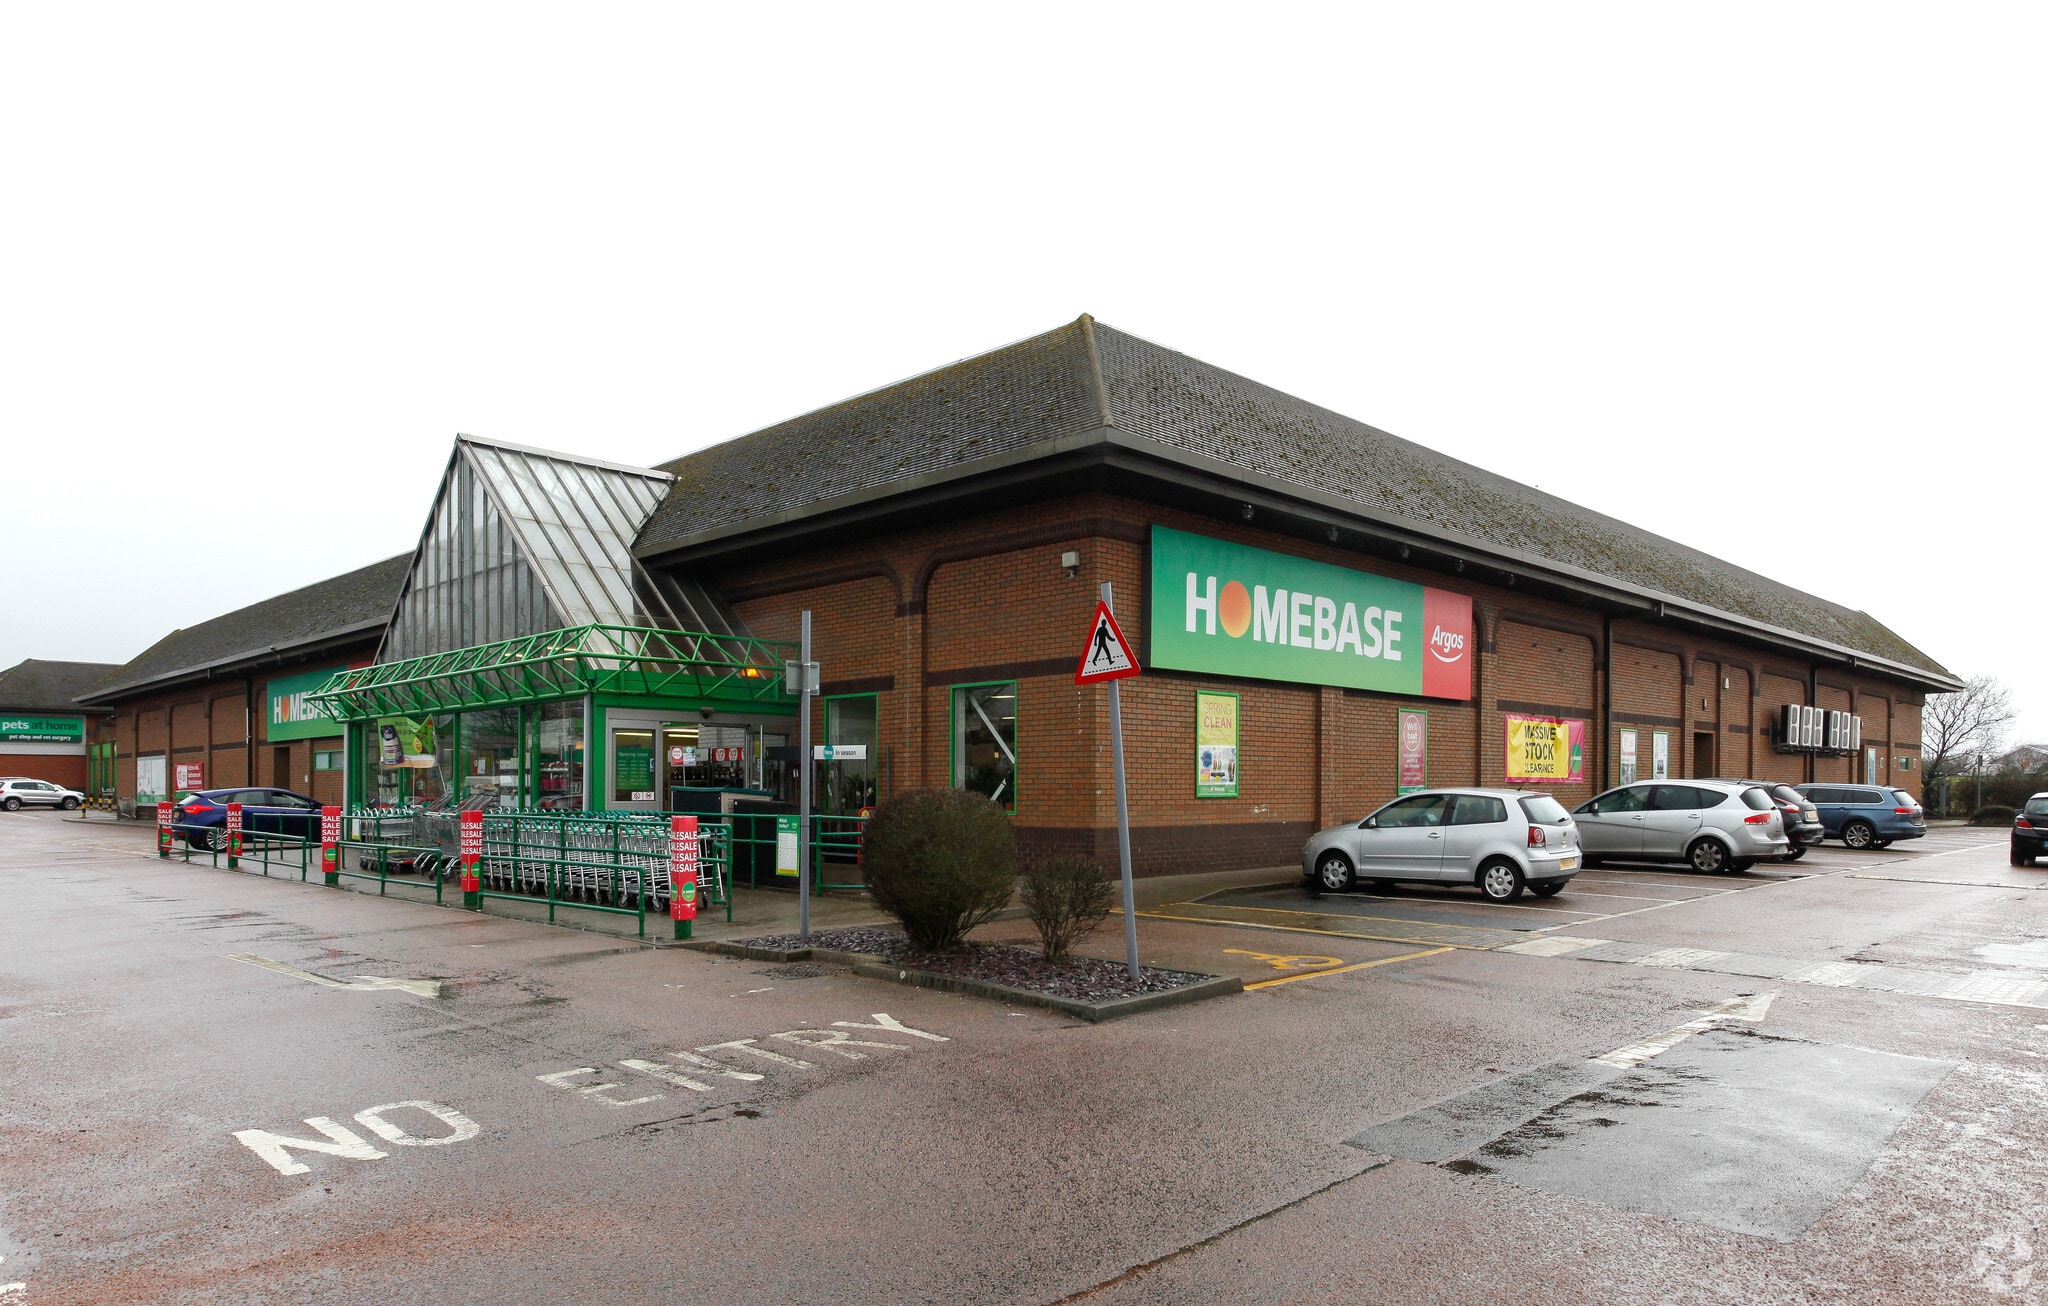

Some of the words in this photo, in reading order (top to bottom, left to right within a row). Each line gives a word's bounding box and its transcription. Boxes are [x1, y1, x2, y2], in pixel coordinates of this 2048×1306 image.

[1186, 572, 1402, 661] HOMEBASE
[1431, 625, 1464, 653] Argos
[1204, 702, 1232, 715] SPRING
[2, 720, 29, 731] pets
[31, 721, 43, 730] at
[45, 720, 78, 731] home
[1203, 716, 1232, 728] CLEAN
[1524, 725, 1556, 740] MASSIVE
[1524, 742, 1554, 760] STOCK
[680, 831, 697, 840] SALE
[469, 847, 483, 855] SALE
[680, 842, 697, 851] SALE
[680, 852, 697, 862] SALE
[680, 863, 697, 872] SALE
[232, 1100, 480, 1175] NO
[535, 1013, 950, 1109] ENTRY
